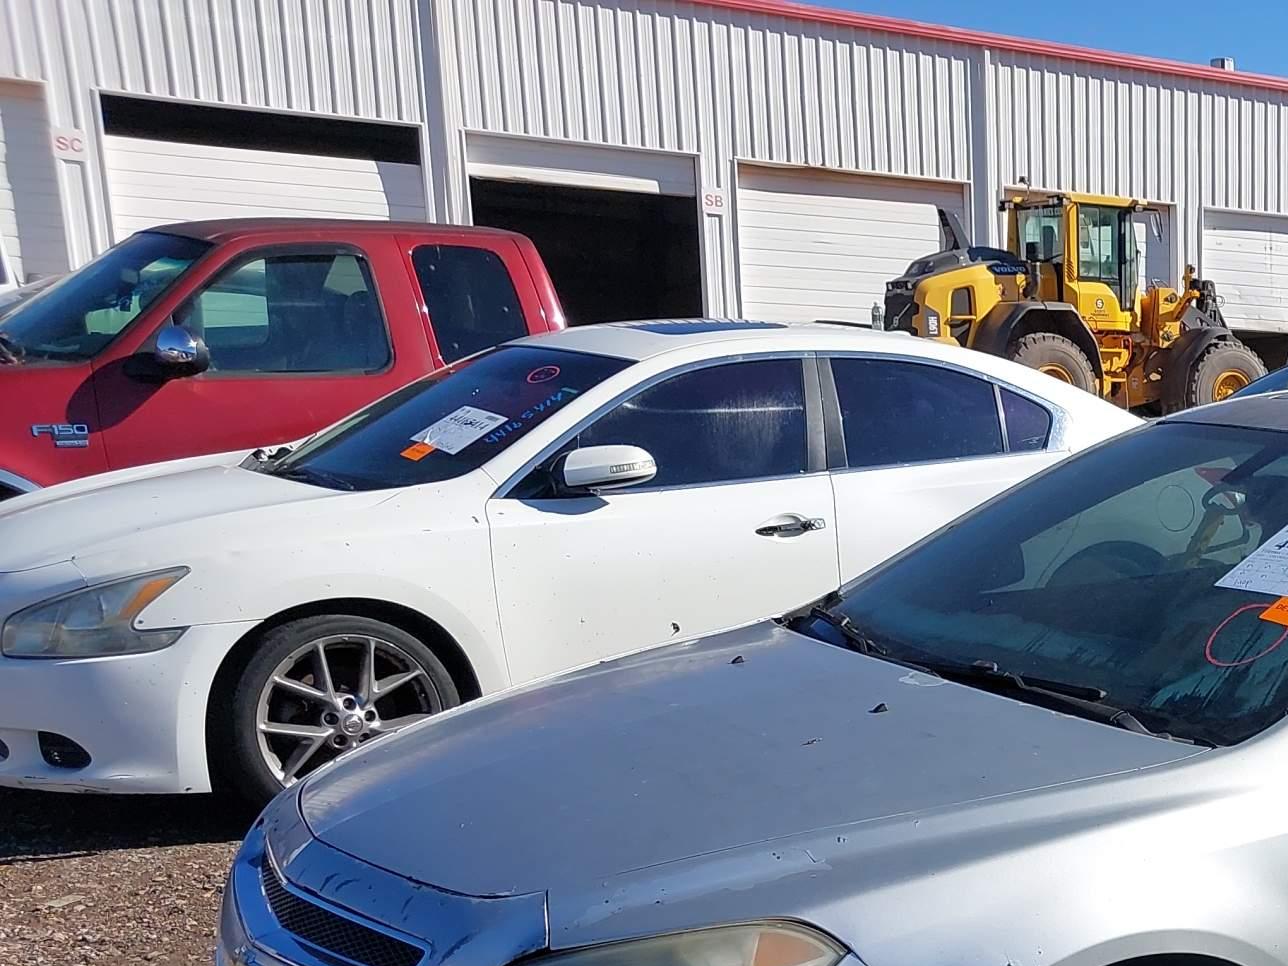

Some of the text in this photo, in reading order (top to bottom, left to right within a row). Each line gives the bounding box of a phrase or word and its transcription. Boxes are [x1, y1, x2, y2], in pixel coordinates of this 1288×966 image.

[55, 135, 84, 153] SC
[704, 193, 724, 208] SB
[992, 264, 1027, 274] VOLVO
[928, 315, 939, 335] L90H
